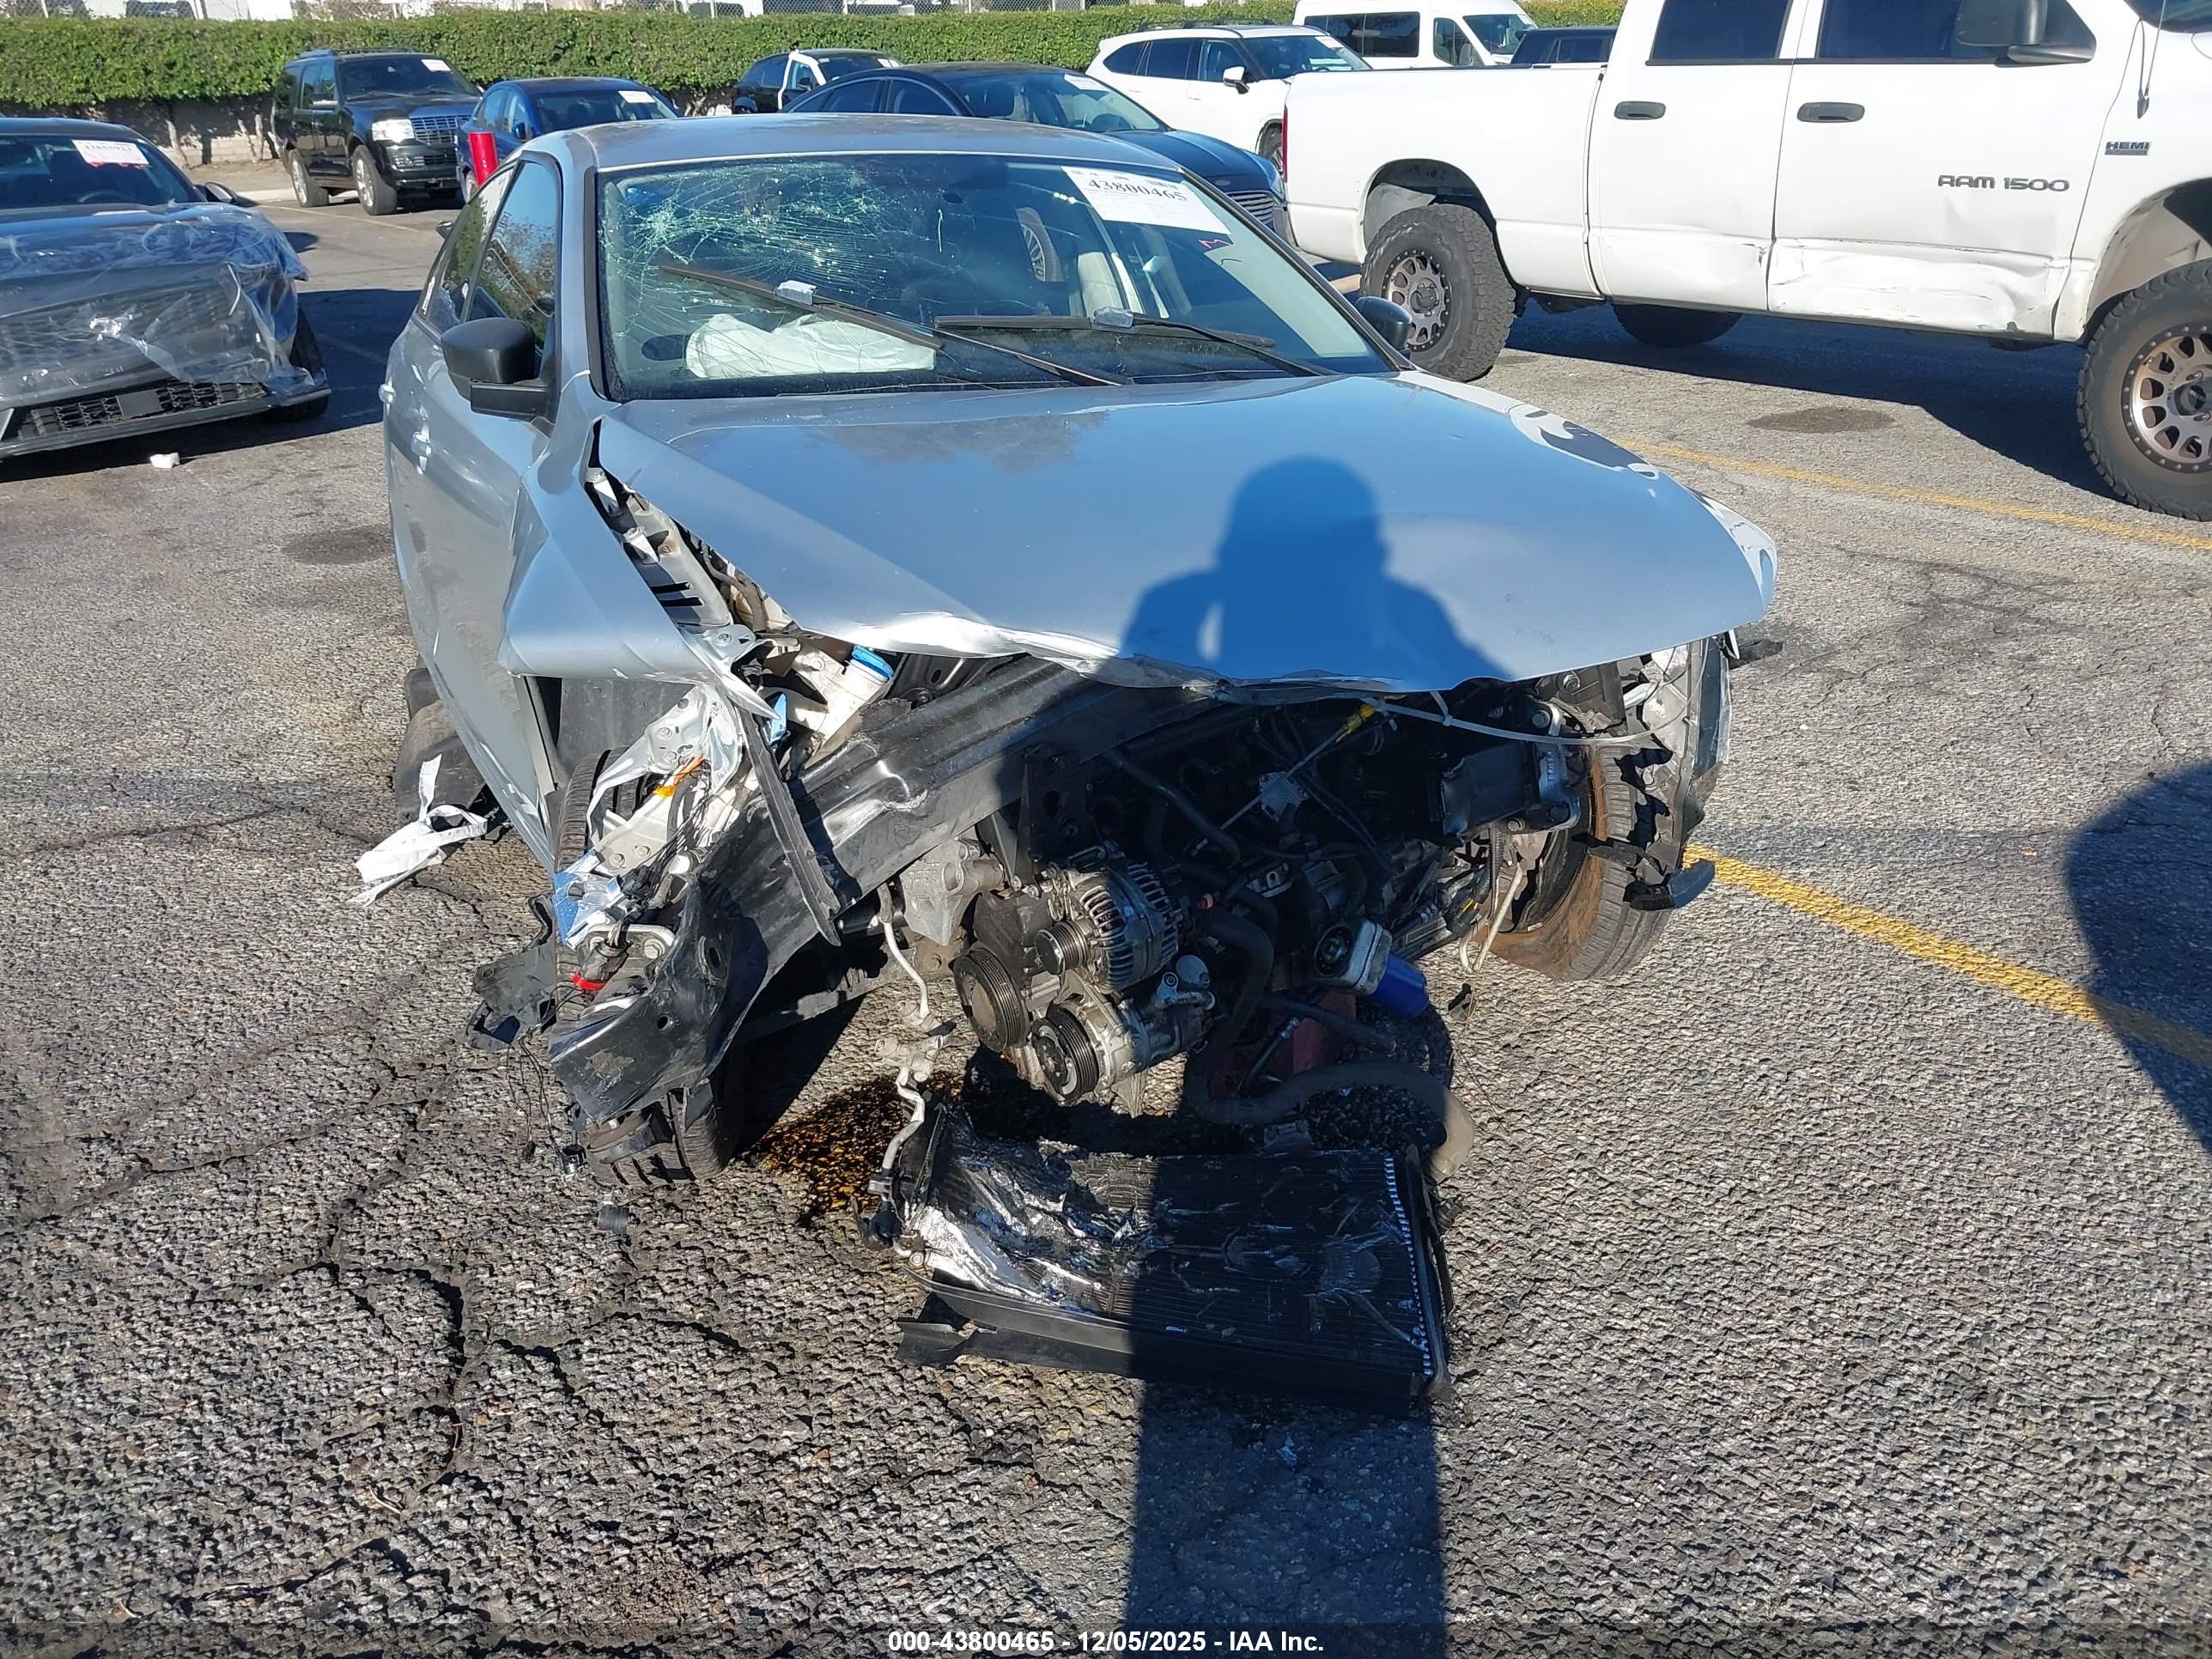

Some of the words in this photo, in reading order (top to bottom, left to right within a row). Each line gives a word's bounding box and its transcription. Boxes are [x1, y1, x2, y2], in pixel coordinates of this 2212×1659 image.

[2106, 141, 2150, 150] HEMI
[1088, 178, 1188, 203] 43800465
[1938, 174, 1995, 190] RAM
[2003, 177, 2070, 192] 1500
